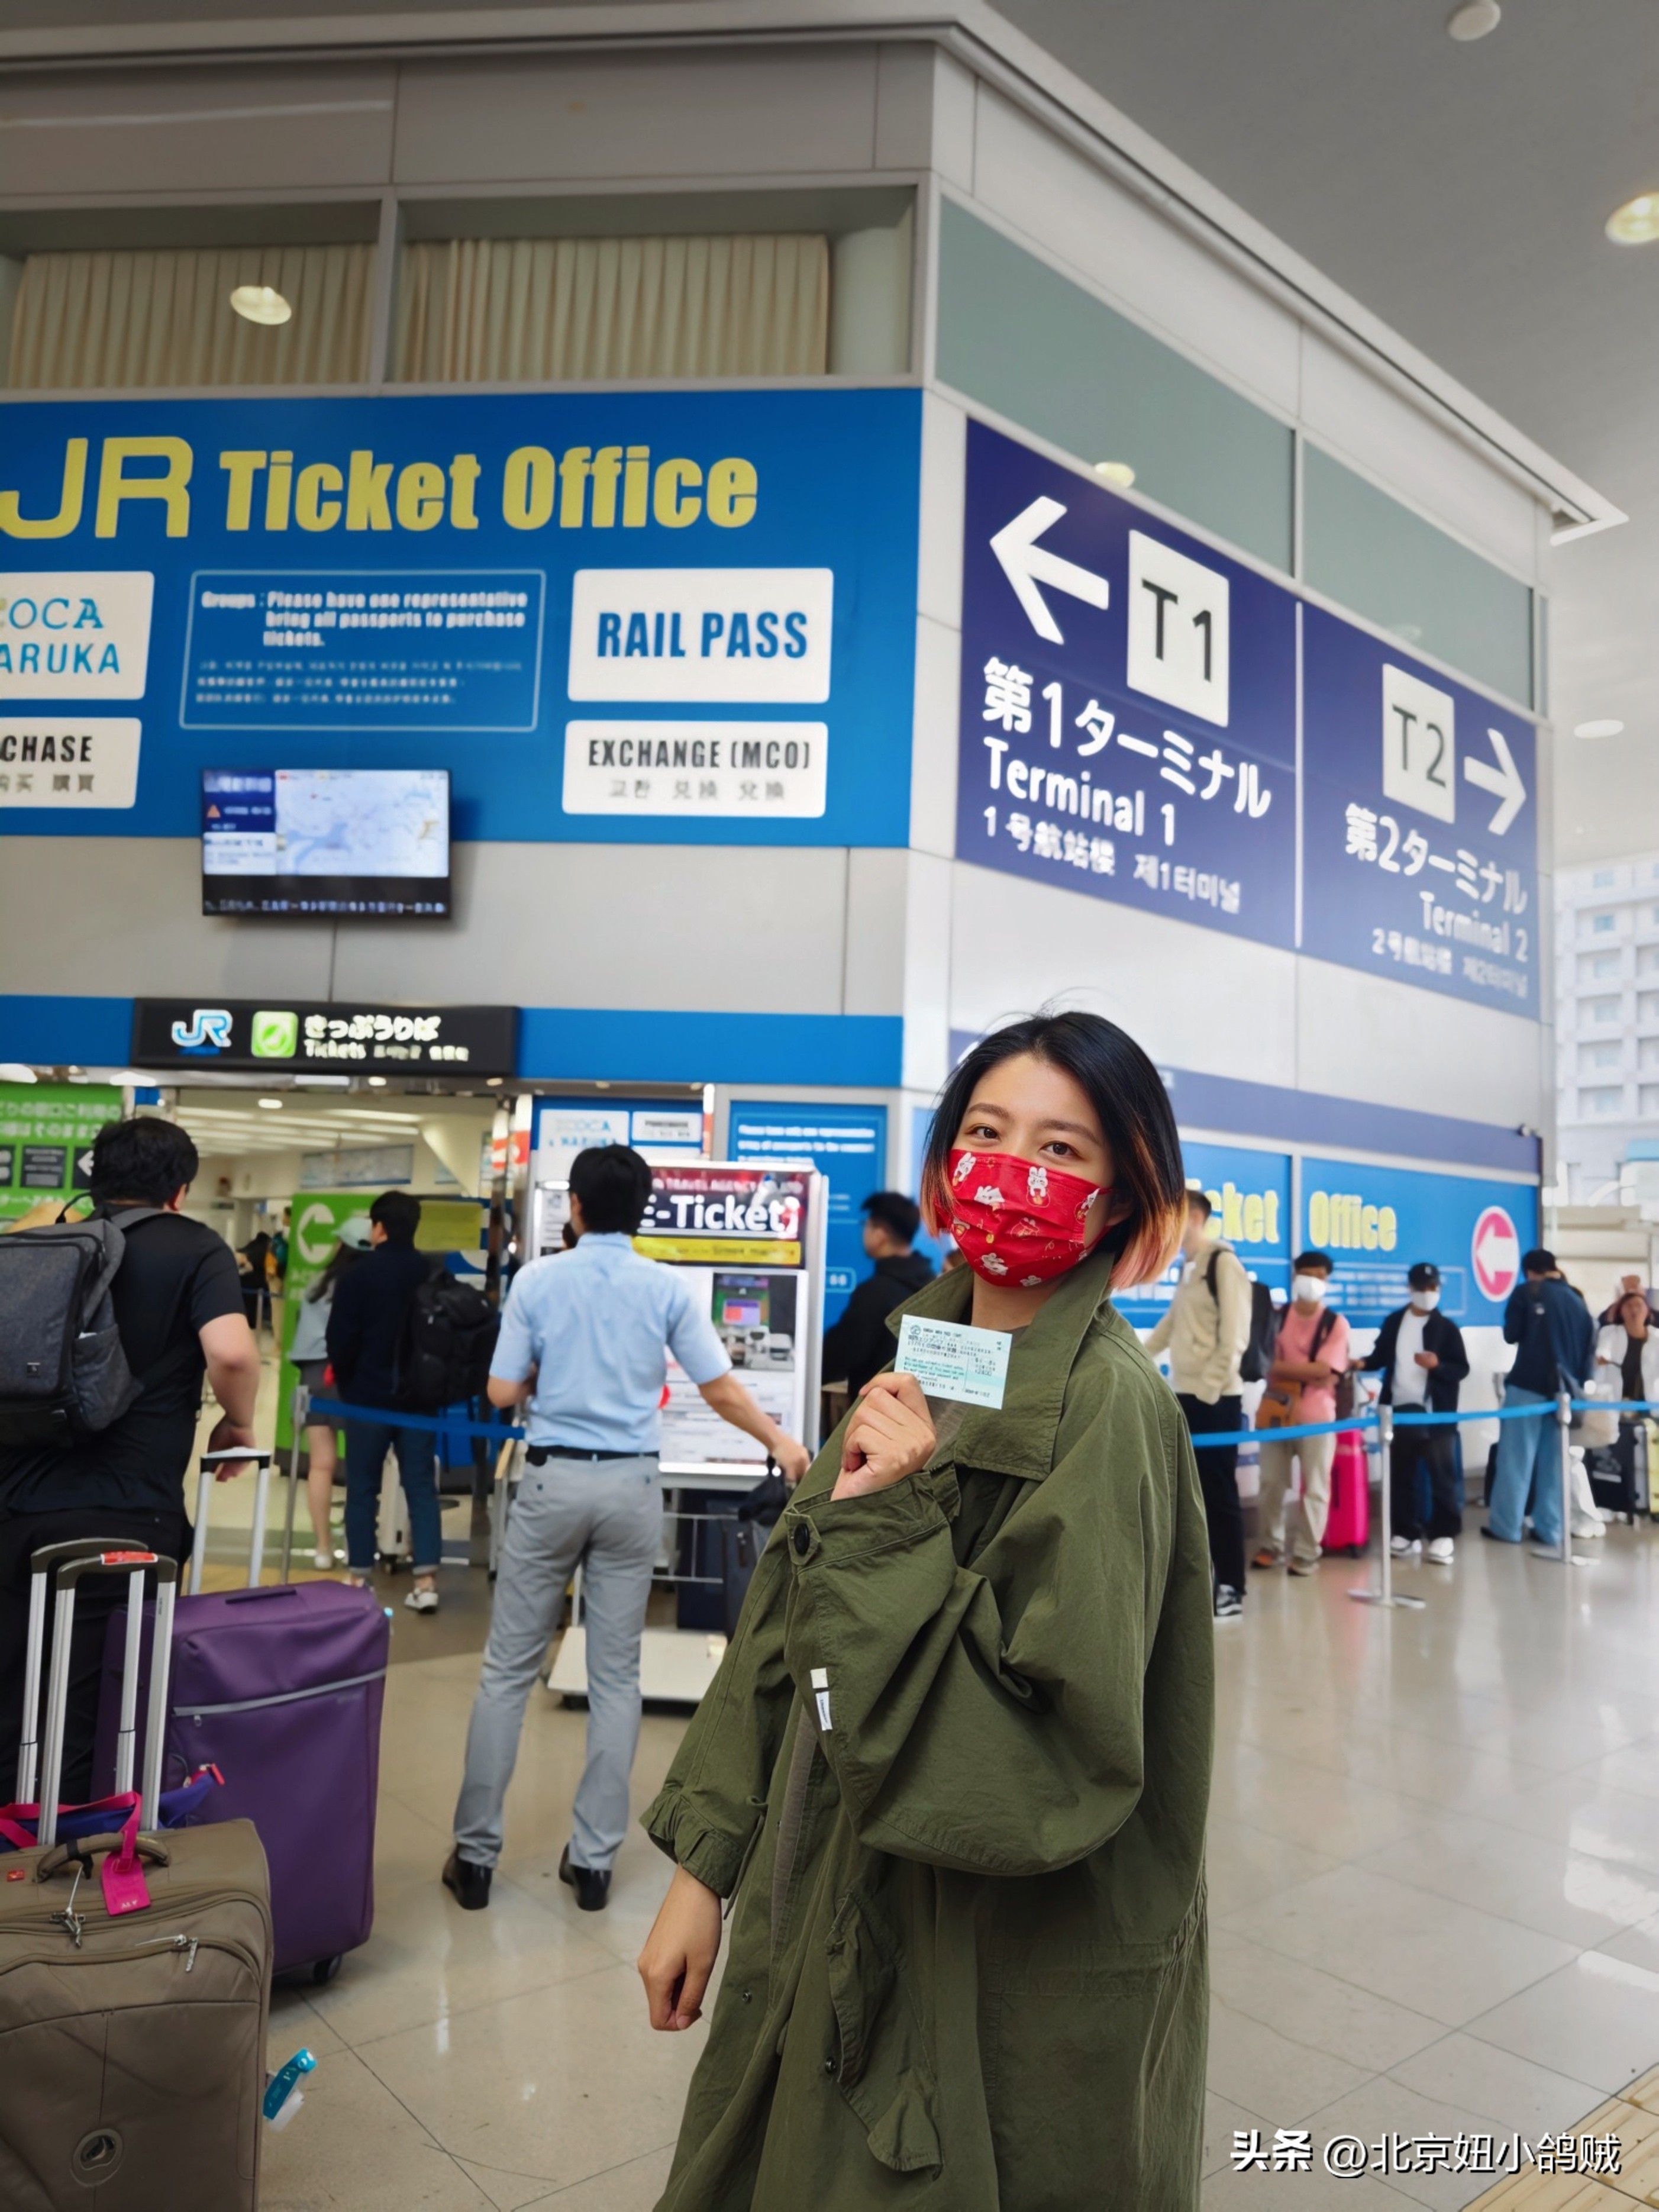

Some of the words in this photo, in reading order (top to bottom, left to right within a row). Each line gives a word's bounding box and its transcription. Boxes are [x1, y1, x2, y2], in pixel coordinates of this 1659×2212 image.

[0, 436, 193, 539] JR
[220, 450, 481, 531] Ticket
[503, 446, 758, 530] Office
[0, 598, 104, 629] OCA
[597, 612, 686, 659] RAIL
[702, 611, 808, 659] PASS
[1142, 578, 1212, 683] T1
[0, 643, 120, 674] ARUKA
[0, 735, 93, 762] CHASE
[589, 740, 720, 768] EXCHANGE
[983, 656, 1271, 818] 第1ターミナル
[1392, 703, 1446, 788] T2
[983, 736, 1144, 836] Terminal
[1161, 803, 1175, 846] 1
[1345, 803, 1528, 914] 第2ターミナル
[1515, 928, 1528, 963] 2
[171, 1010, 233, 1047] JR
[1184, 1178, 1280, 1244] cket
[1309, 1191, 1397, 1252] Office
